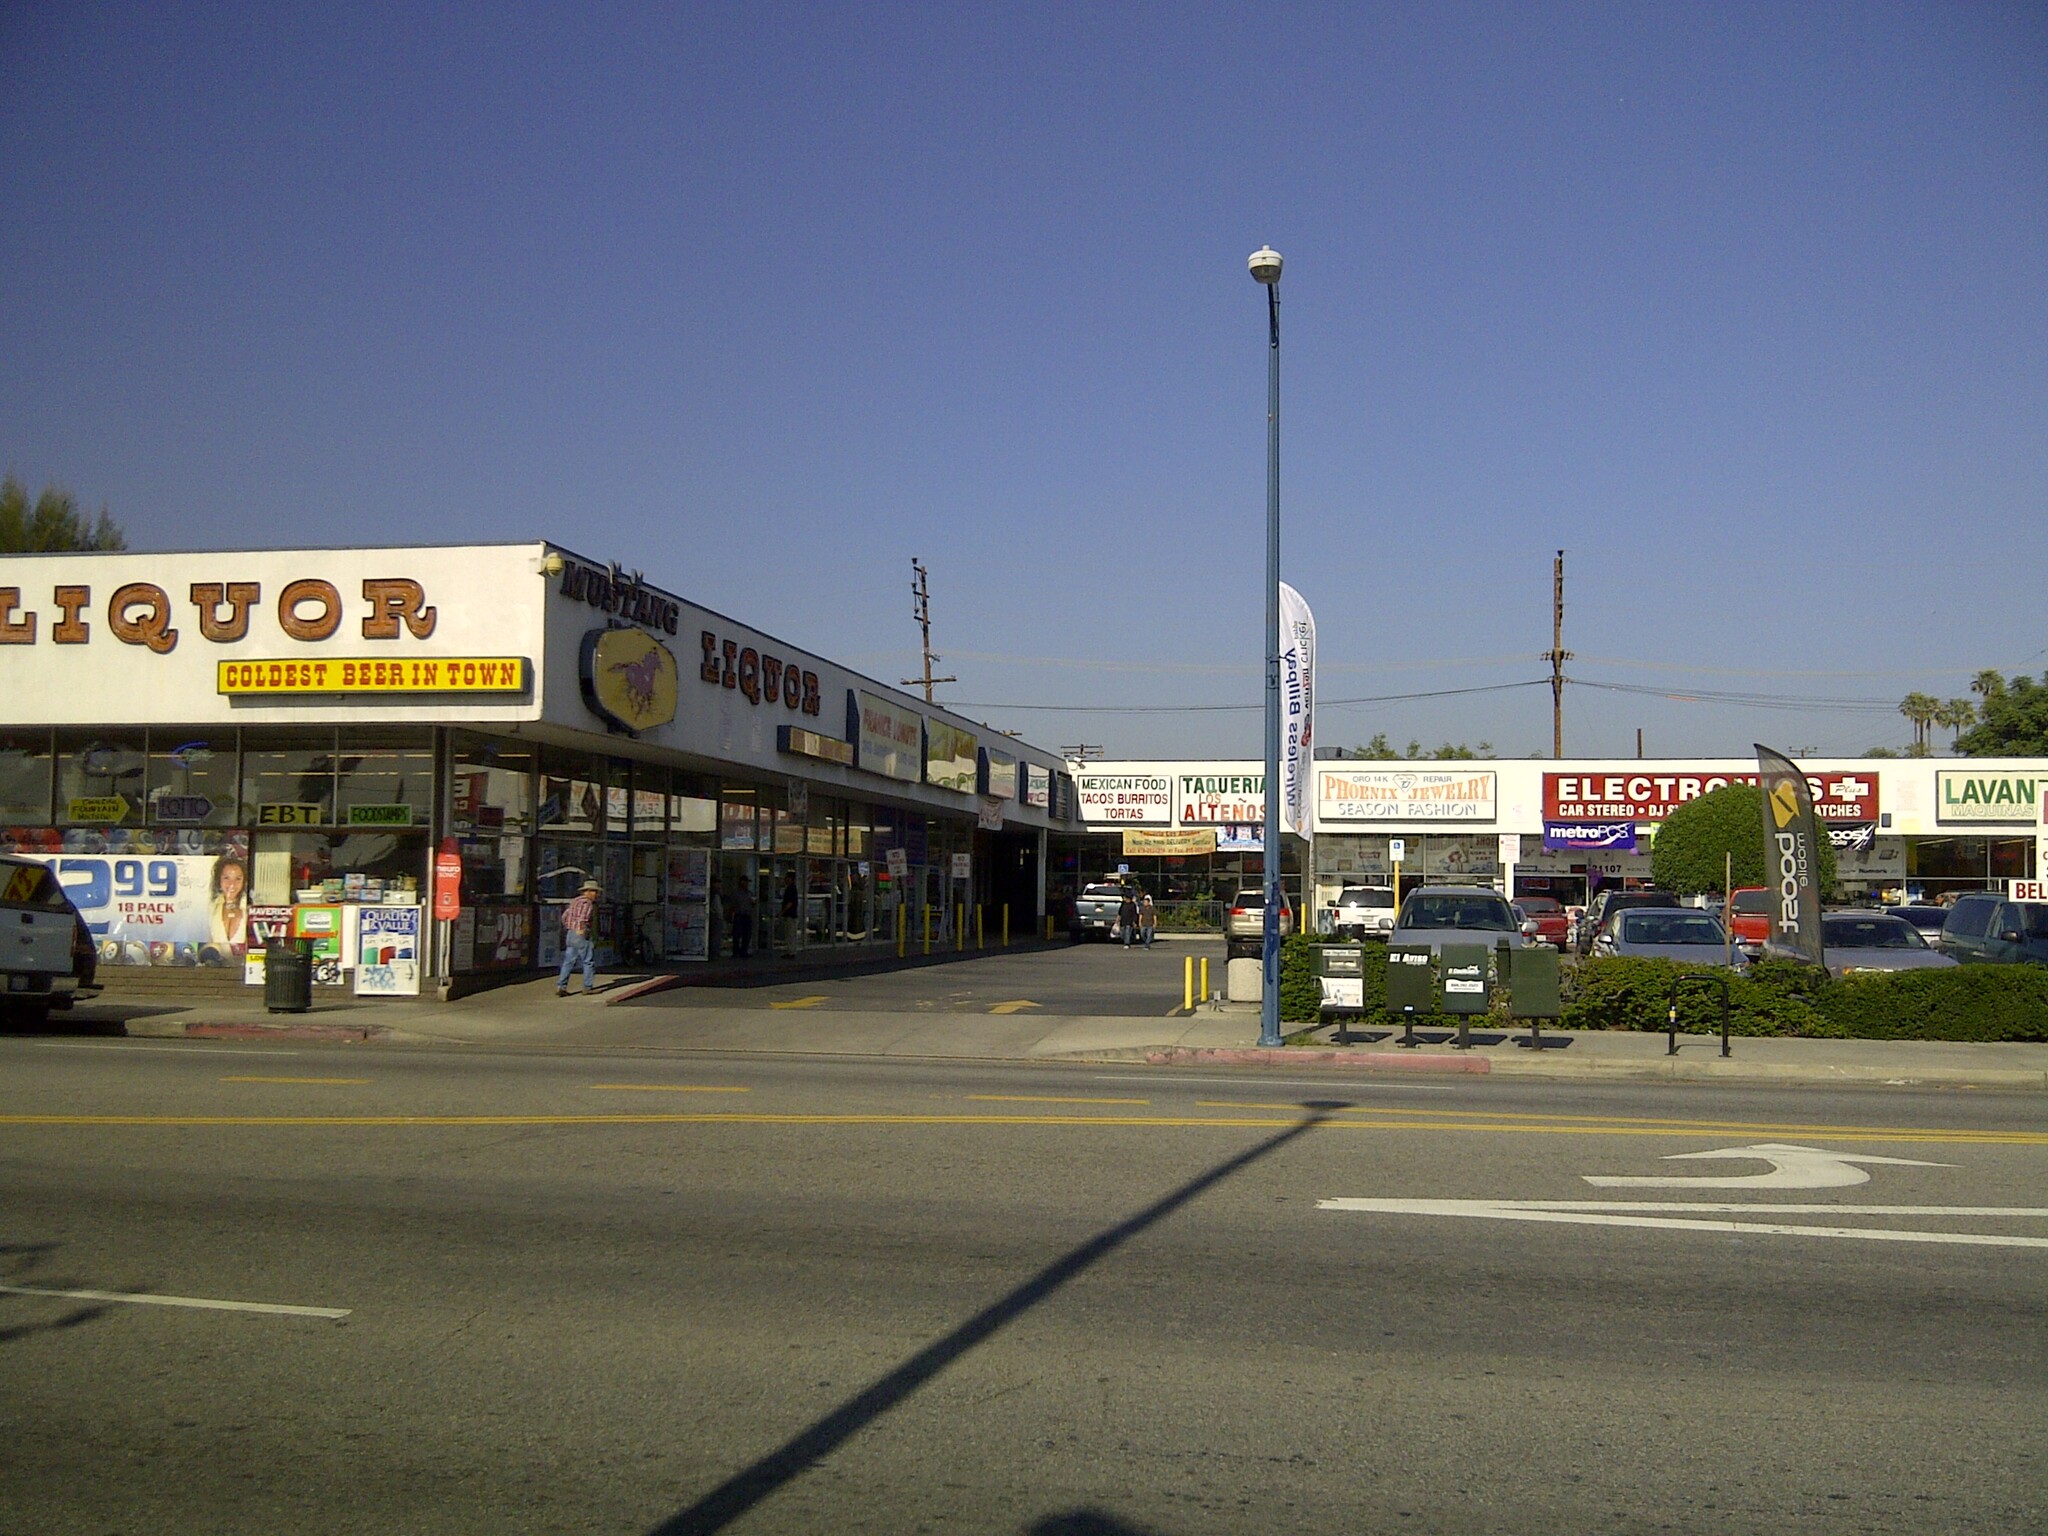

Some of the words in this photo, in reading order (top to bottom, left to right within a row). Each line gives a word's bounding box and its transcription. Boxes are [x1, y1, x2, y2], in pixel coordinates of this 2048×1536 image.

[560, 560, 680, 635] MUSTANG
[0, 578, 437, 655] LIQUOR
[226, 663, 328, 687] COLDEST
[342, 663, 406, 687] BEER
[411, 663, 439, 686] IN
[446, 662, 516, 686] TOWN
[700, 631, 821, 716] LIQUOR
[1081, 778, 1132, 790] MEXICAN
[1134, 778, 1167, 790] FOOD
[1324, 774, 1398, 800] PHOENIX
[1408, 774, 1491, 800] JEWELRY
[1834, 784, 1862, 794] Plus
[1945, 779, 2035, 804] LAVAN
[1080, 793, 1114, 804] TACOS
[1117, 793, 1169, 804] BURRITOS
[1199, 793, 1221, 804] LOS
[1104, 808, 1144, 819] TORTAS
[1338, 803, 1399, 816] SEASON
[1408, 803, 1477, 816] FASHION
[1559, 803, 1584, 817] CAR
[1587, 803, 1635, 817] STEREO
[1648, 803, 1664, 817] DJ
[1951, 804, 2035, 817] MAQUINAS
[118, 902, 134, 913] 18
[137, 902, 175, 913] PACK
[248, 907, 293, 916] MAVERICK
[126, 914, 164, 925] CANS
[366, 909, 413, 921] QUALITY
[380, 920, 411, 930] VALUE
